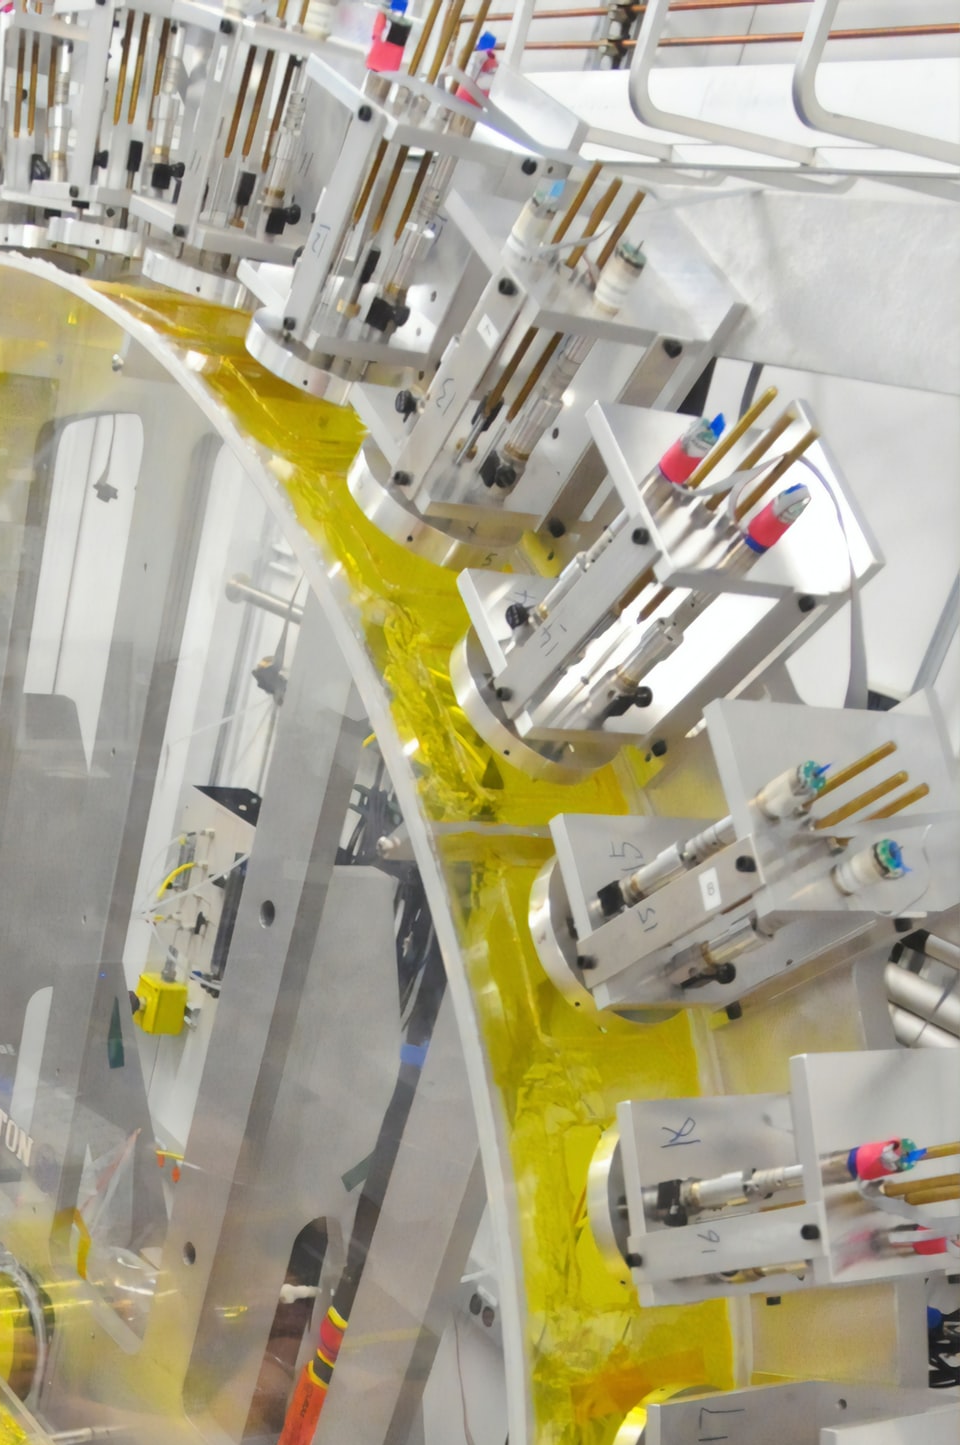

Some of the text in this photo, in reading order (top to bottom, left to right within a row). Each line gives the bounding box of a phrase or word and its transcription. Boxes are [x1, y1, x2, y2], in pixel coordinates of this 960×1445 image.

[436, 378, 457, 417] 13
[637, 907, 658, 933] 15
[696, 1229, 721, 1254] 16
[698, 1406, 746, 1443] 17
